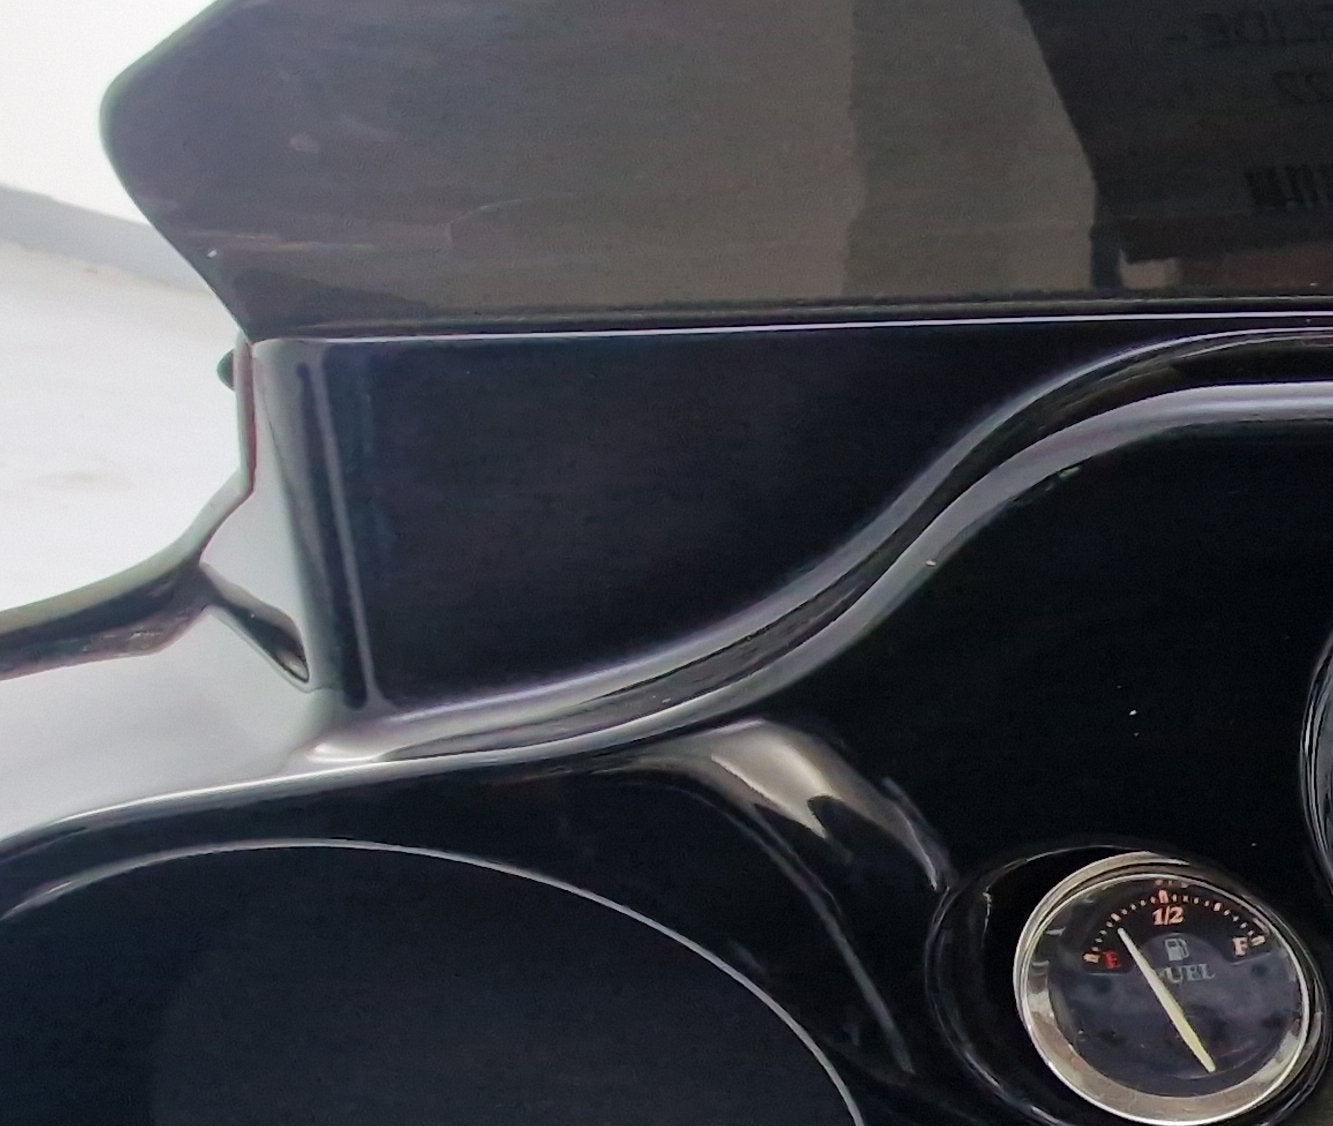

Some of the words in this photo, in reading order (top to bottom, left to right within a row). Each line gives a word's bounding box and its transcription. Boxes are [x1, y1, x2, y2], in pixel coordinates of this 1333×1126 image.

[1151, 905, 1184, 926] 1/2
[1233, 937, 1248, 956] F
[1160, 964, 1216, 983] UEL
